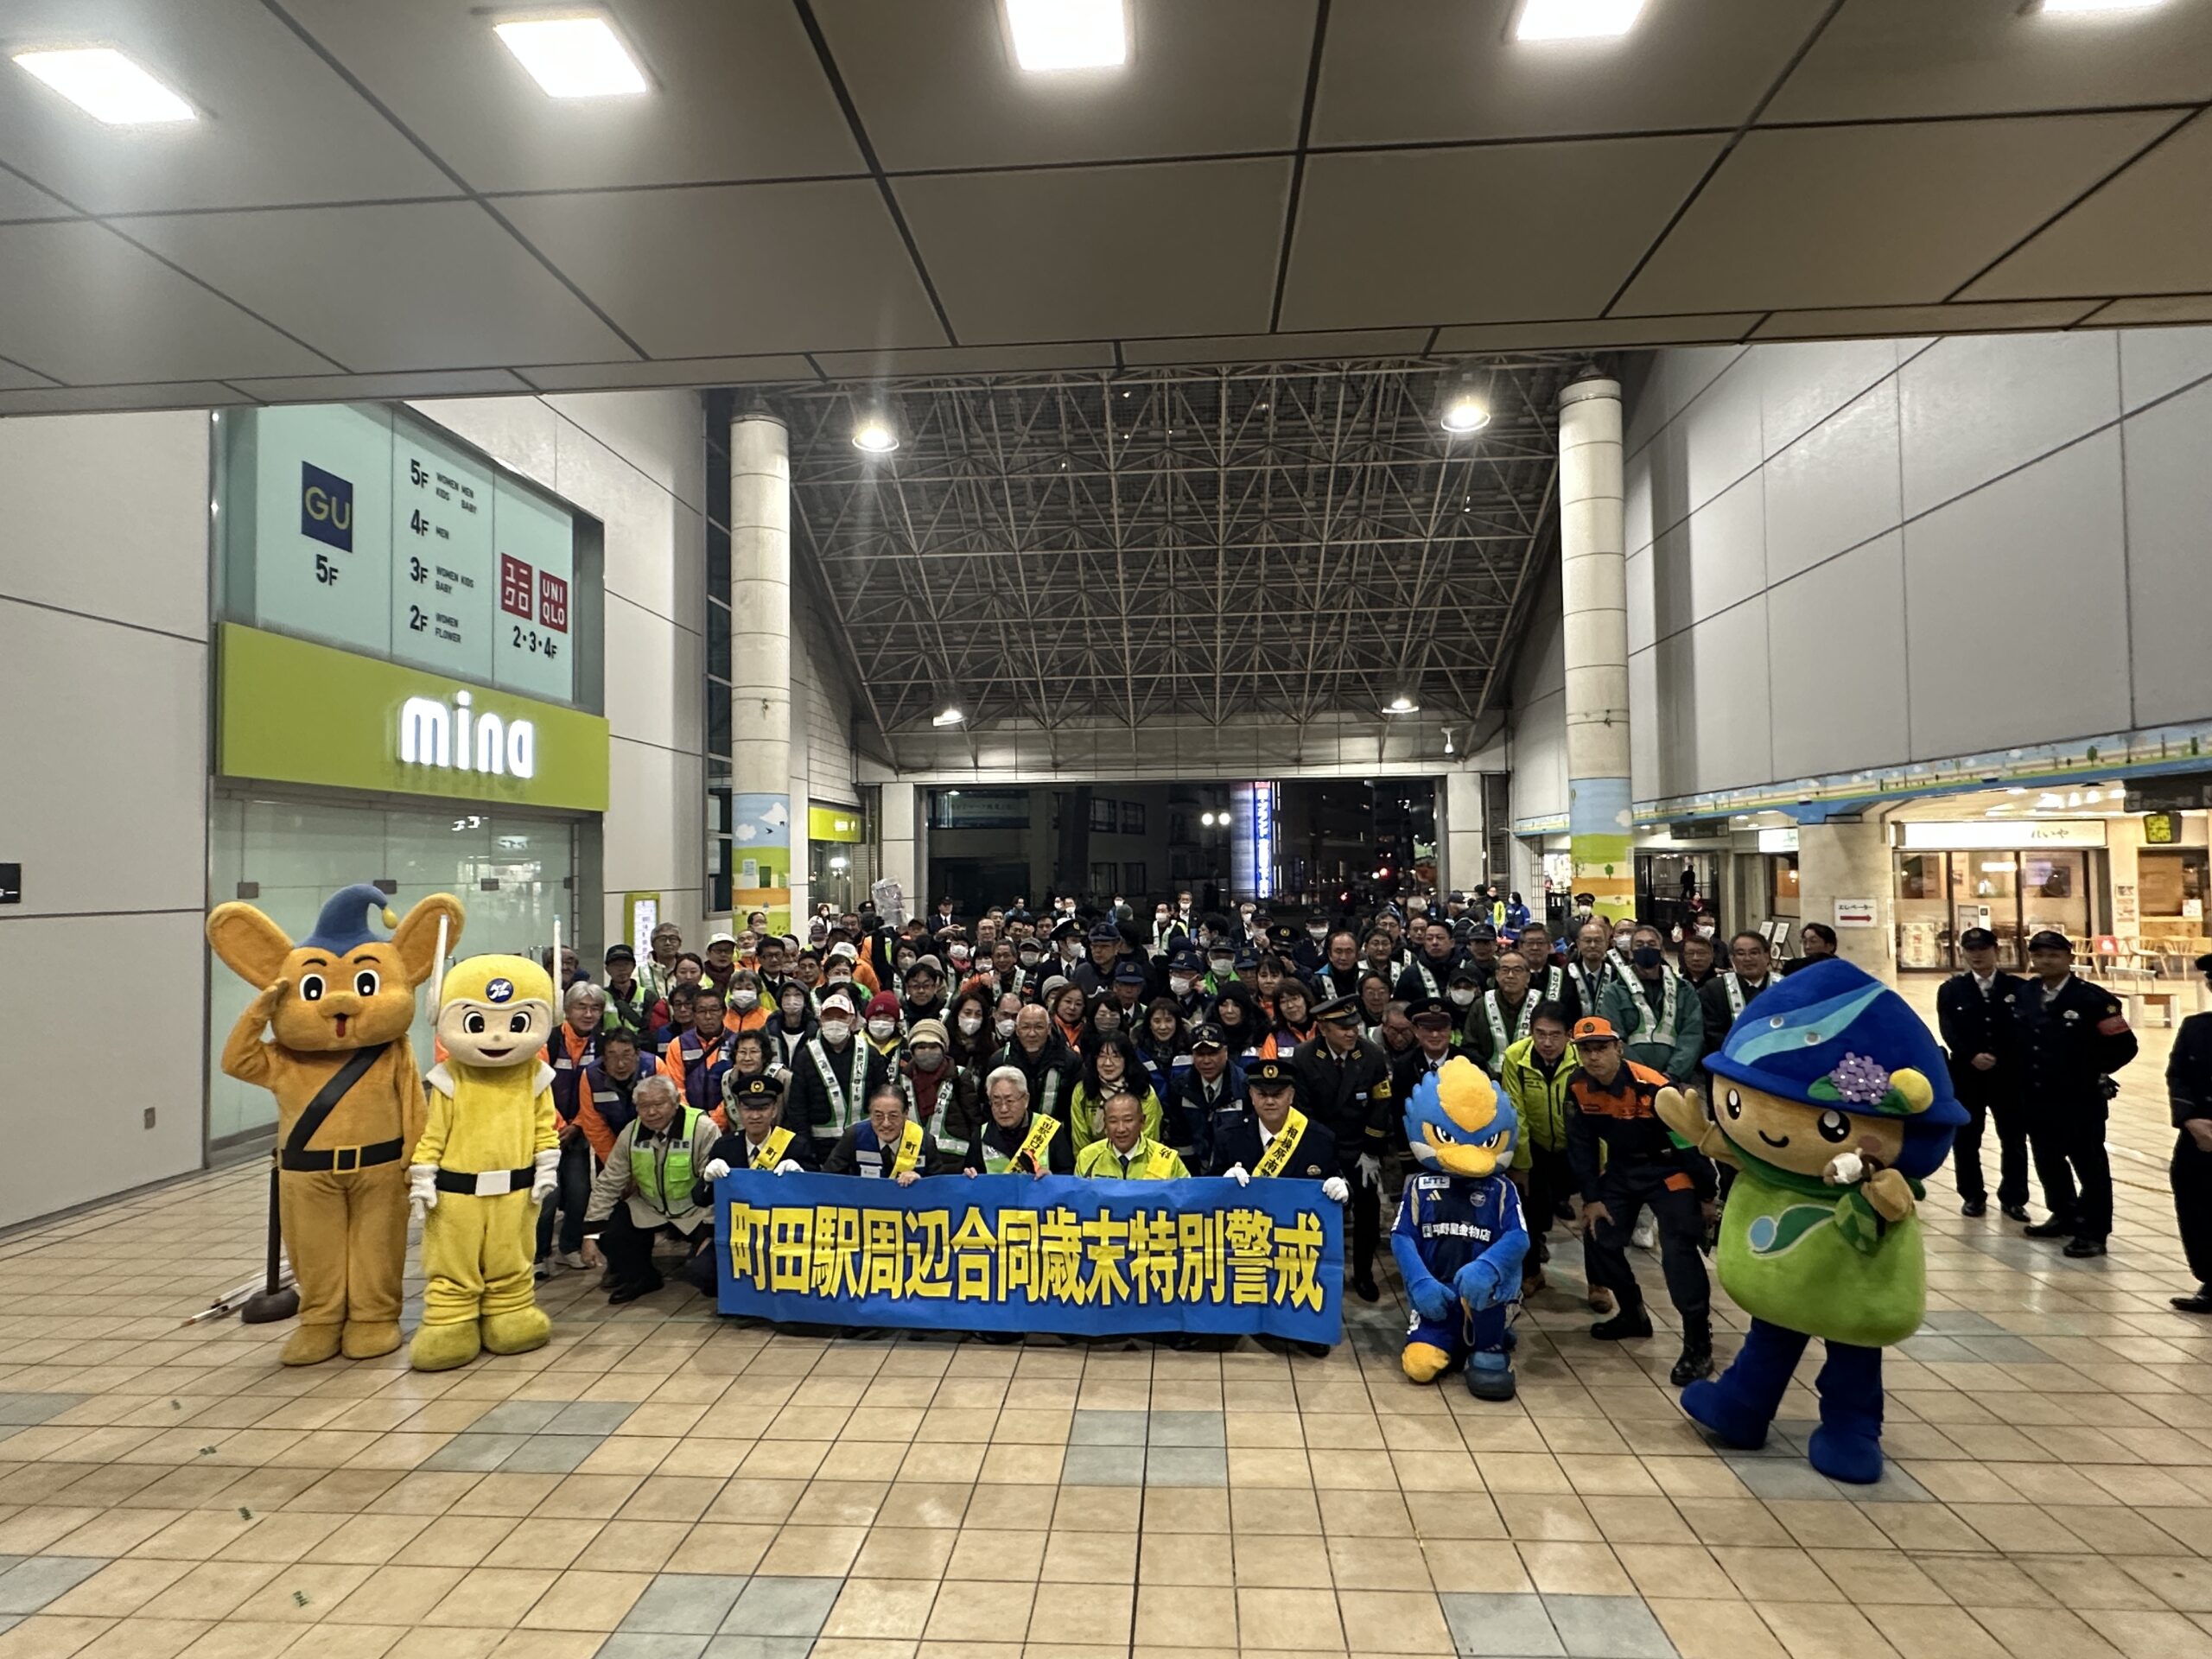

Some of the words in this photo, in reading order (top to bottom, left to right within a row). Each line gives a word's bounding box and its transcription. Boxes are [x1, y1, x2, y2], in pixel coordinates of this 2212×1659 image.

[410, 458, 429, 489] 5F
[435, 471, 460, 492] WOMEN
[461, 485, 474, 499] MEN
[305, 486, 350, 530] GU
[410, 508, 429, 537] 4F
[435, 525, 449, 540] MEN
[316, 553, 339, 587] 5F
[410, 556, 429, 584] 3F
[435, 565, 459, 582] WOMEN
[410, 604, 429, 632] 2F
[435, 612, 459, 628] WOMEN
[435, 626, 461, 644] FLOWER
[401, 690, 535, 779] mina
[729, 1201, 1324, 1313] 町田駅周辺合同歳末特別警戒
